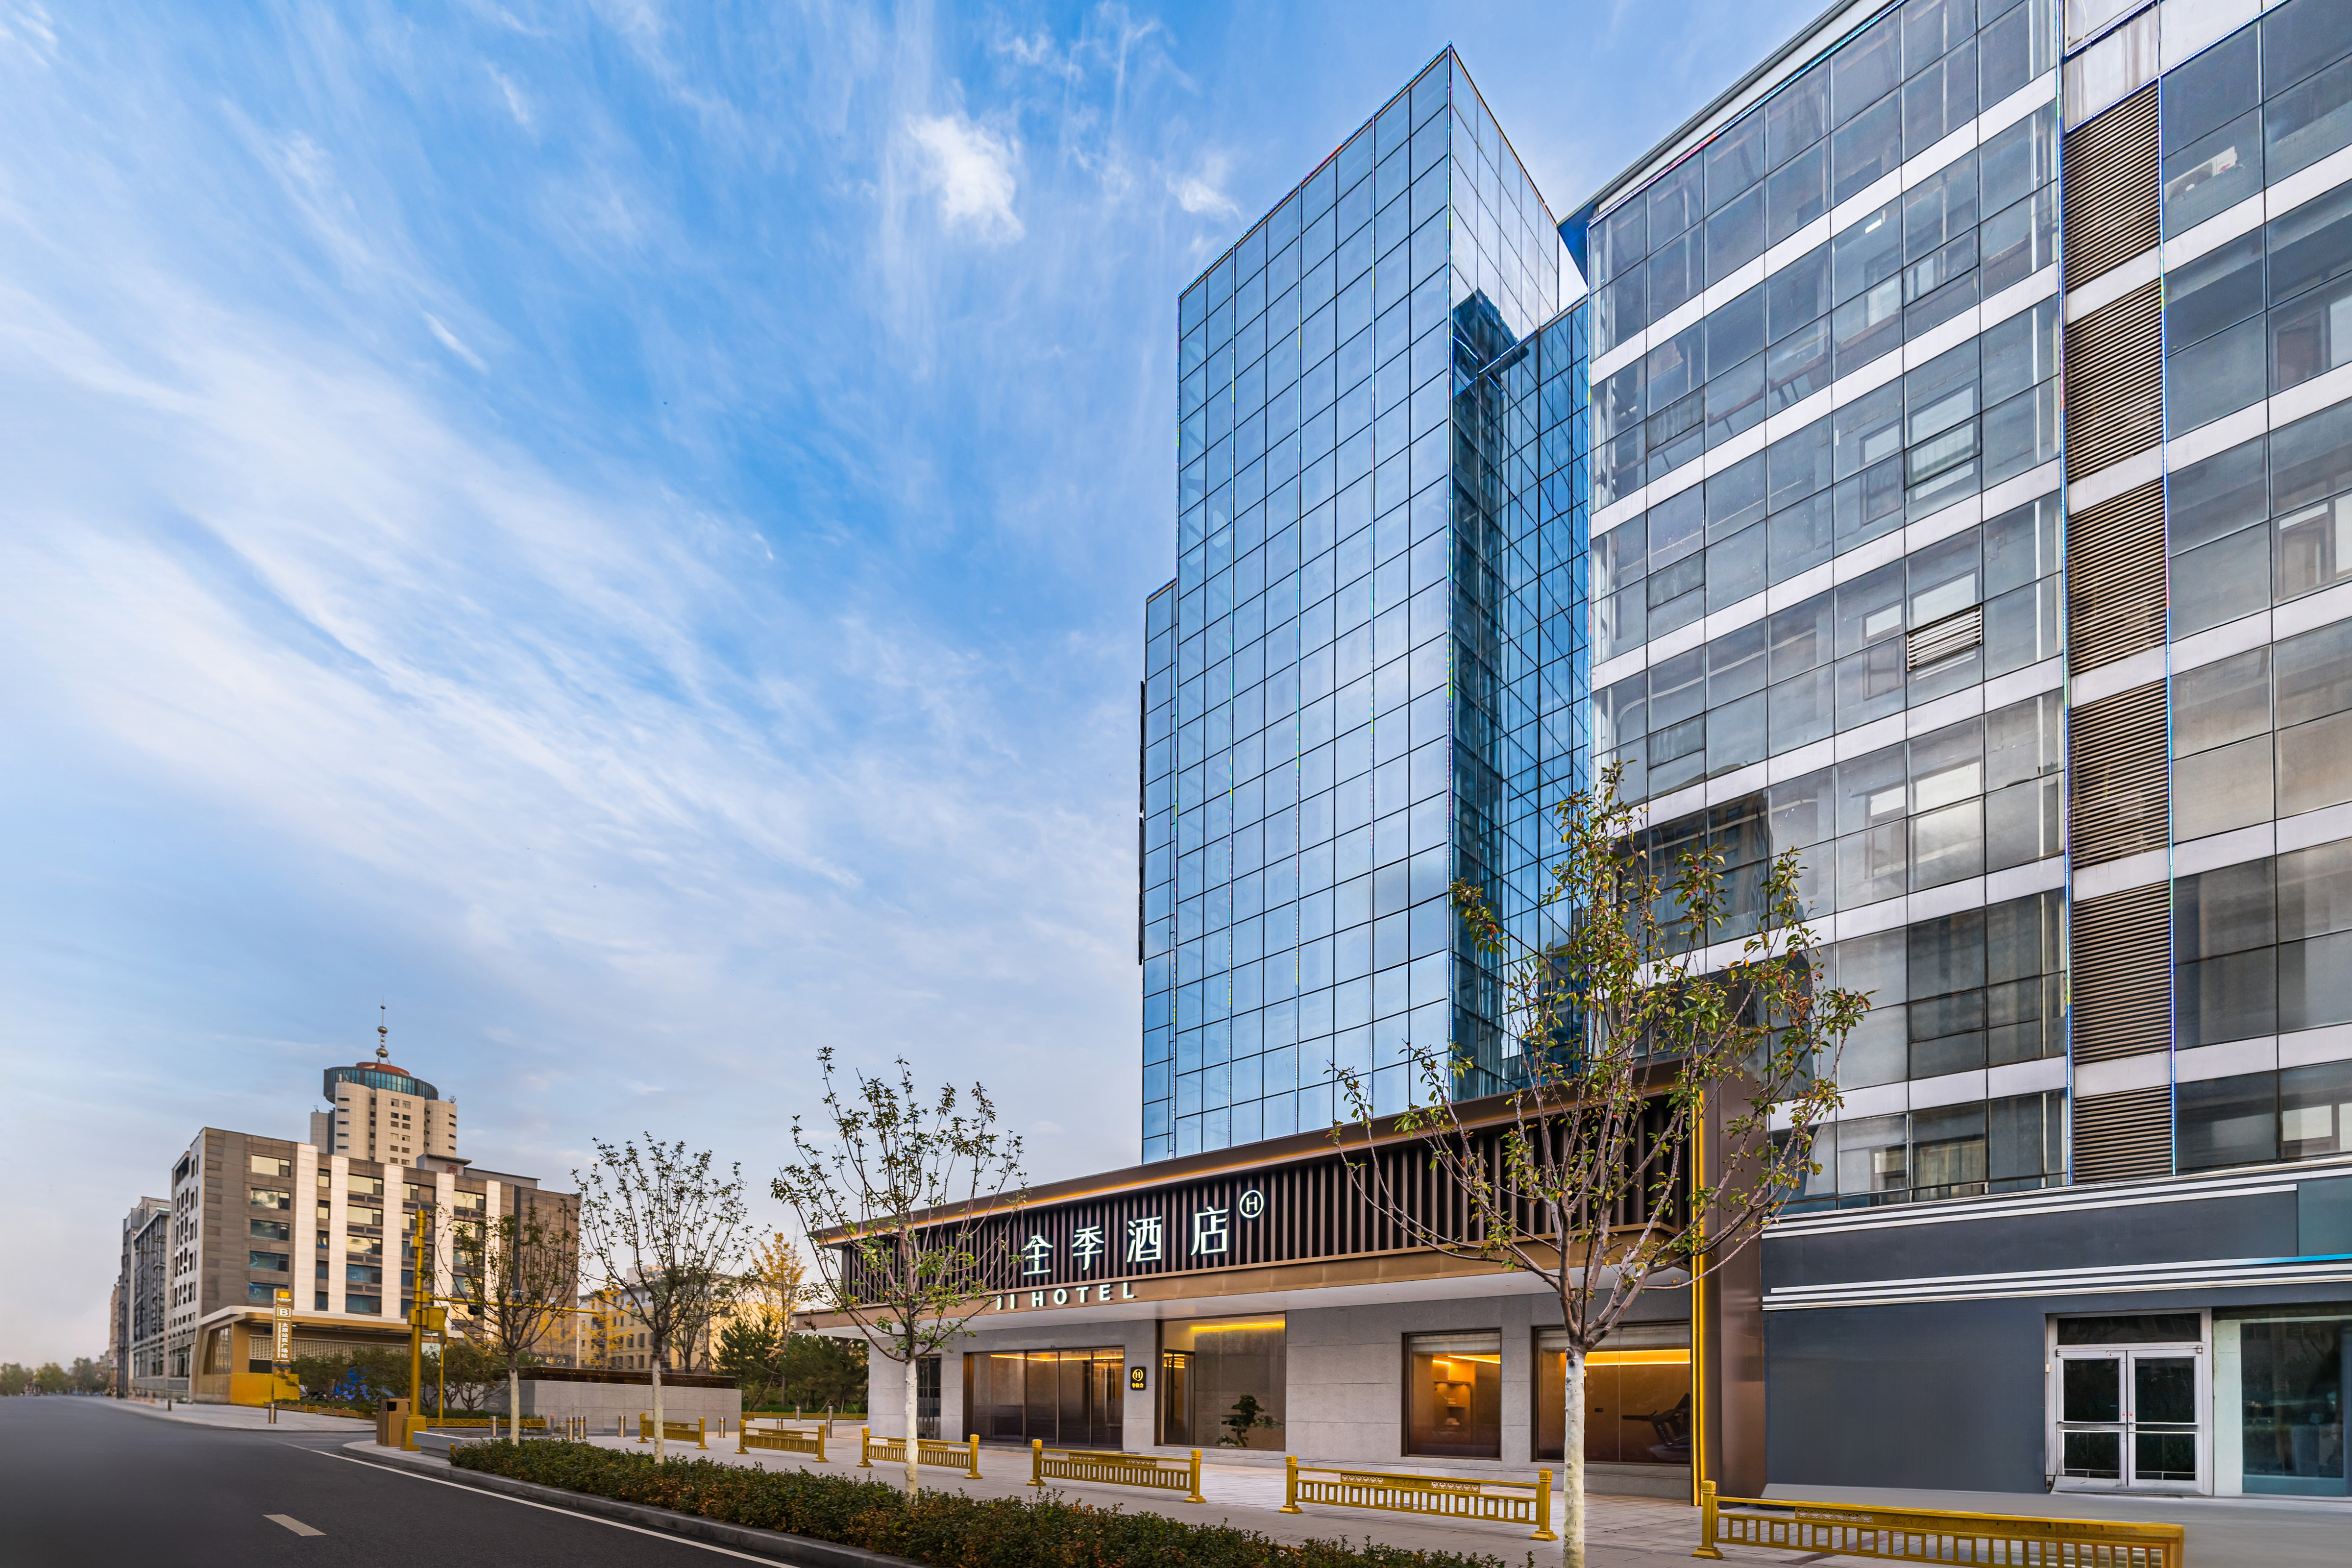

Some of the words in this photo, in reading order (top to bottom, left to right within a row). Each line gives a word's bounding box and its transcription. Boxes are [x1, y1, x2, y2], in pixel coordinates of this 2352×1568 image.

[1021, 1206, 1229, 1275] 全季酒店
[1031, 1282, 1134, 1306] HOTEL
